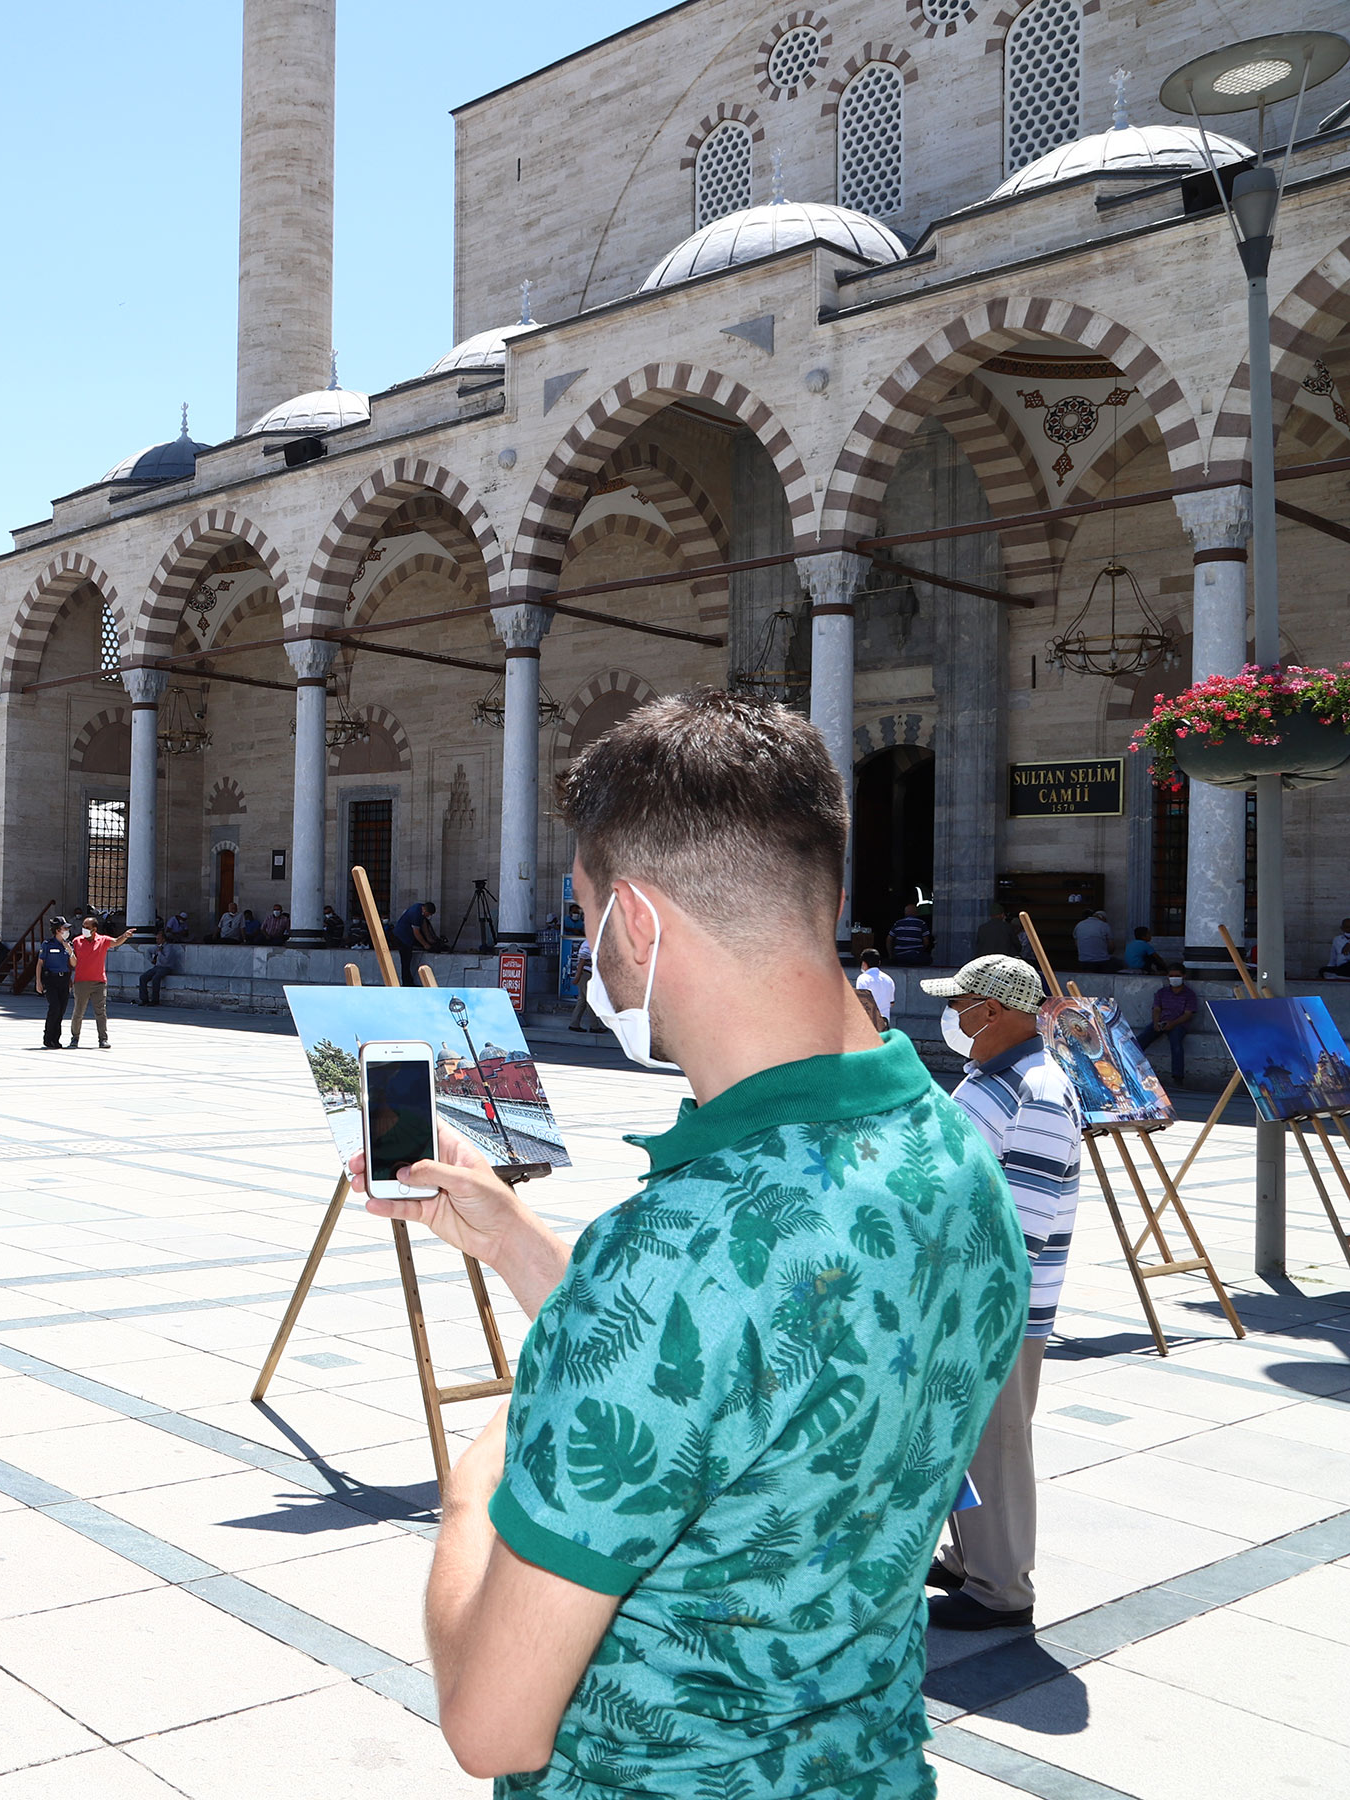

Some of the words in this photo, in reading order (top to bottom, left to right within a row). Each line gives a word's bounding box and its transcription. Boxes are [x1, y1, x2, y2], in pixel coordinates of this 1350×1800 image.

[1013, 770, 1065, 785] SULTAN
[1070, 764, 1117, 784] SELİM
[1038, 784, 1090, 804] CAMİİ
[1052, 804, 1075, 813] 1570
